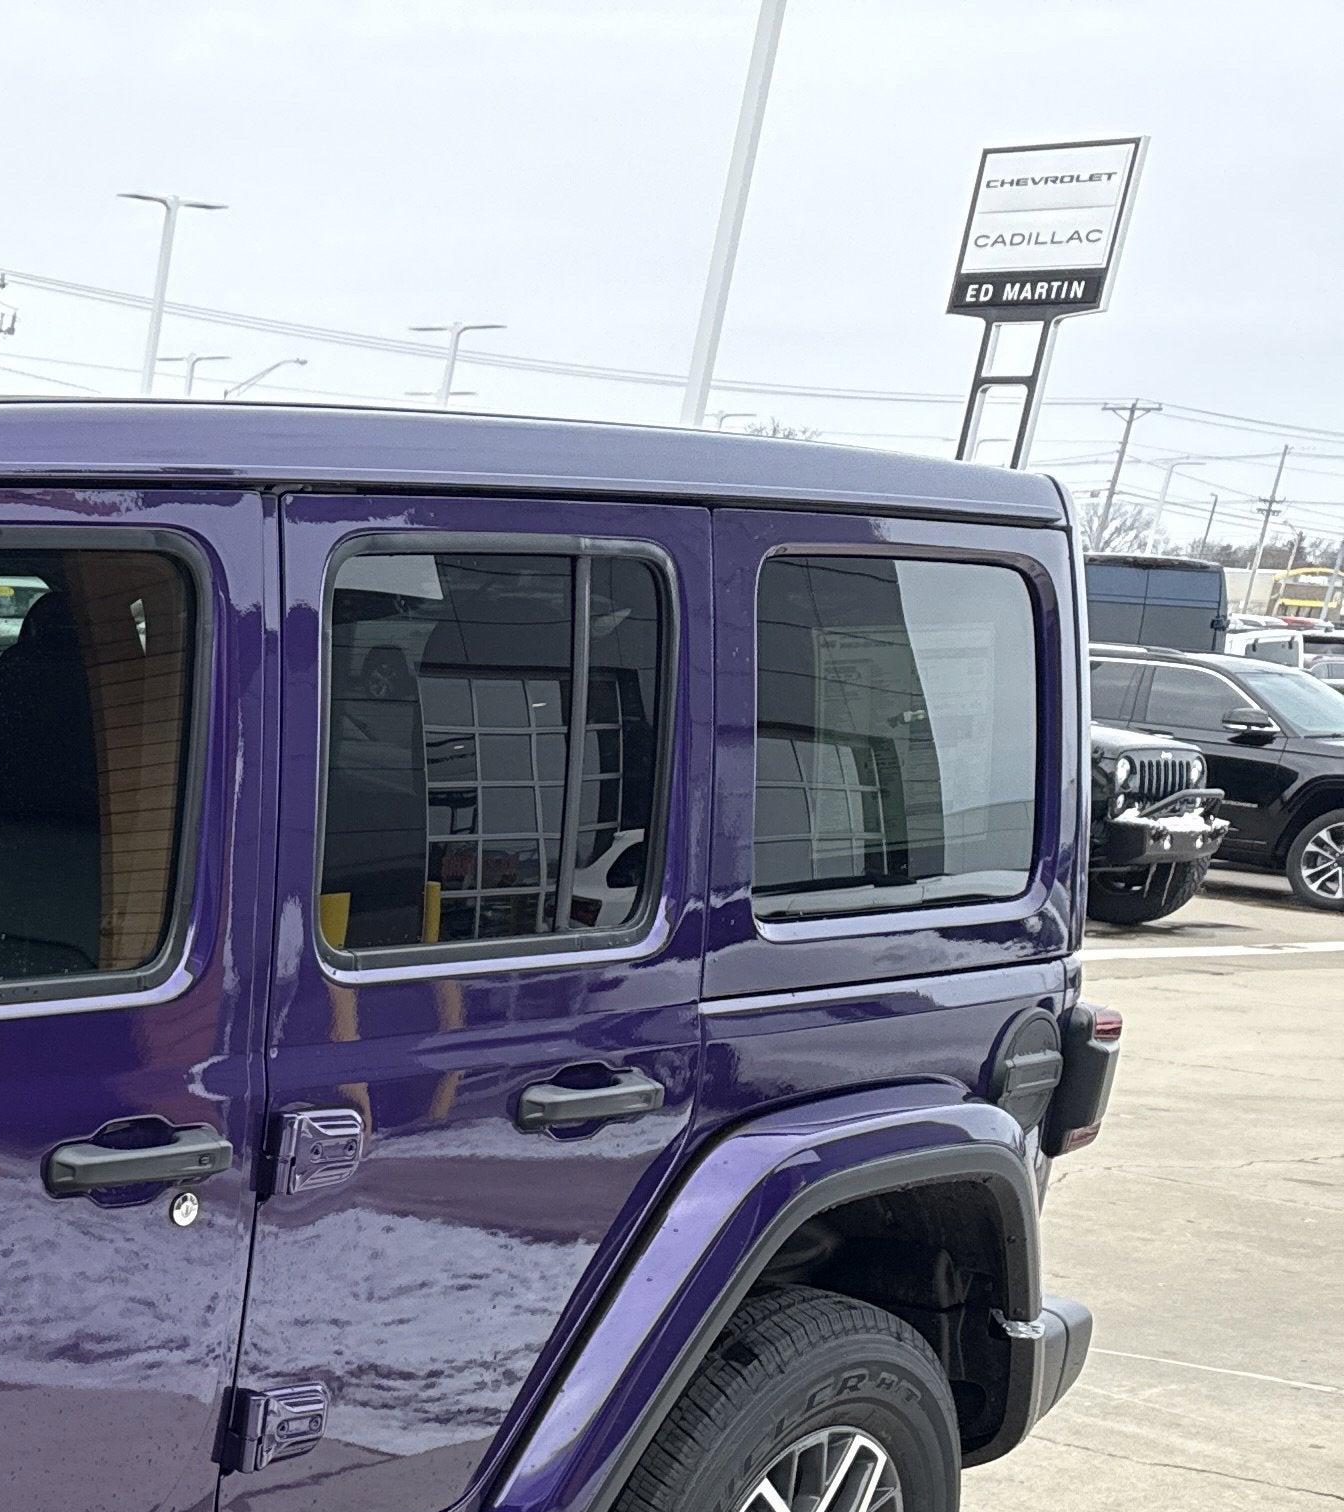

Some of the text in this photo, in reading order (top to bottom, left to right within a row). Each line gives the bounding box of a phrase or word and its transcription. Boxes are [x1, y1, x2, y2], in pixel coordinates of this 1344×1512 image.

[985, 171, 1118, 189] CHEVROLET
[973, 228, 1104, 248] CADILLAC
[965, 279, 1086, 302] ED MARTIN
